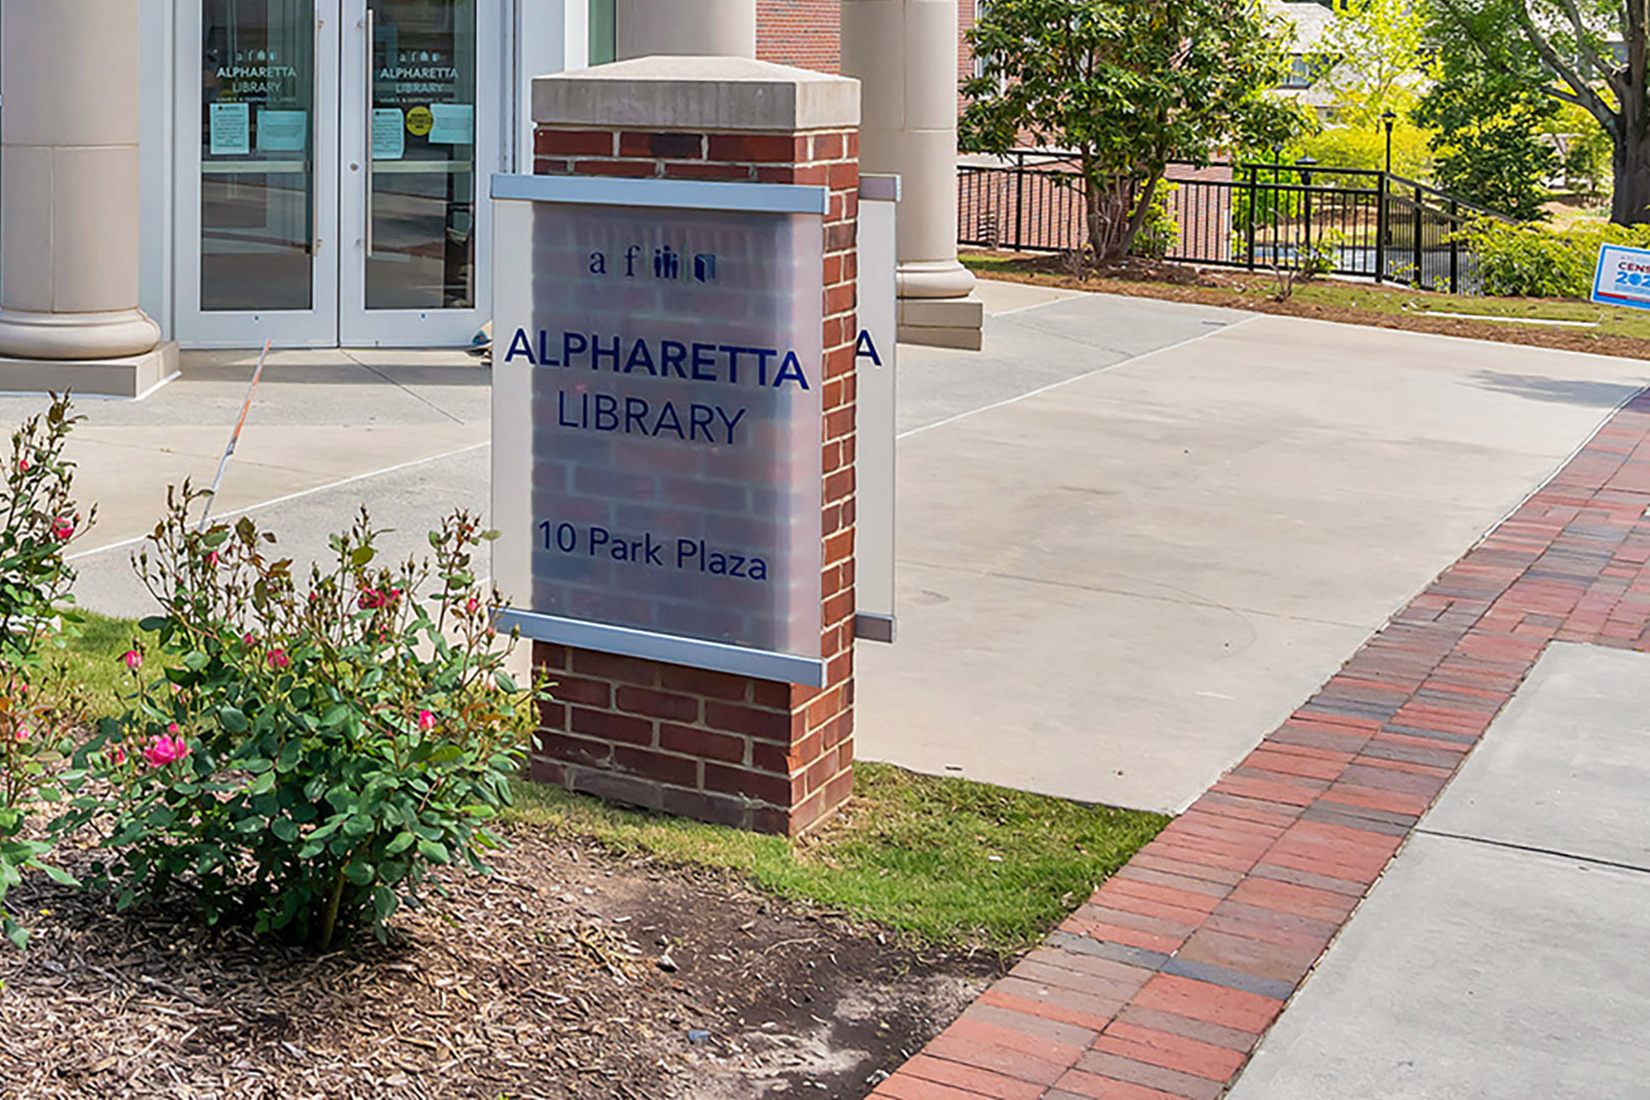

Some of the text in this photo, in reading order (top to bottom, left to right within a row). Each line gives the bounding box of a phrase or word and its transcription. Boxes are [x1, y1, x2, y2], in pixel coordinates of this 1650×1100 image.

[216, 66, 297, 78] ALPHARETTA
[380, 67, 459, 79] ALPHARETTA
[232, 81, 282, 93] LIBRARY
[395, 82, 444, 93] LIBRARY
[504, 327, 810, 391] ALPHARETTA
[558, 390, 746, 445] LIBRARY
[538, 520, 768, 581] 10 Park Plaza
